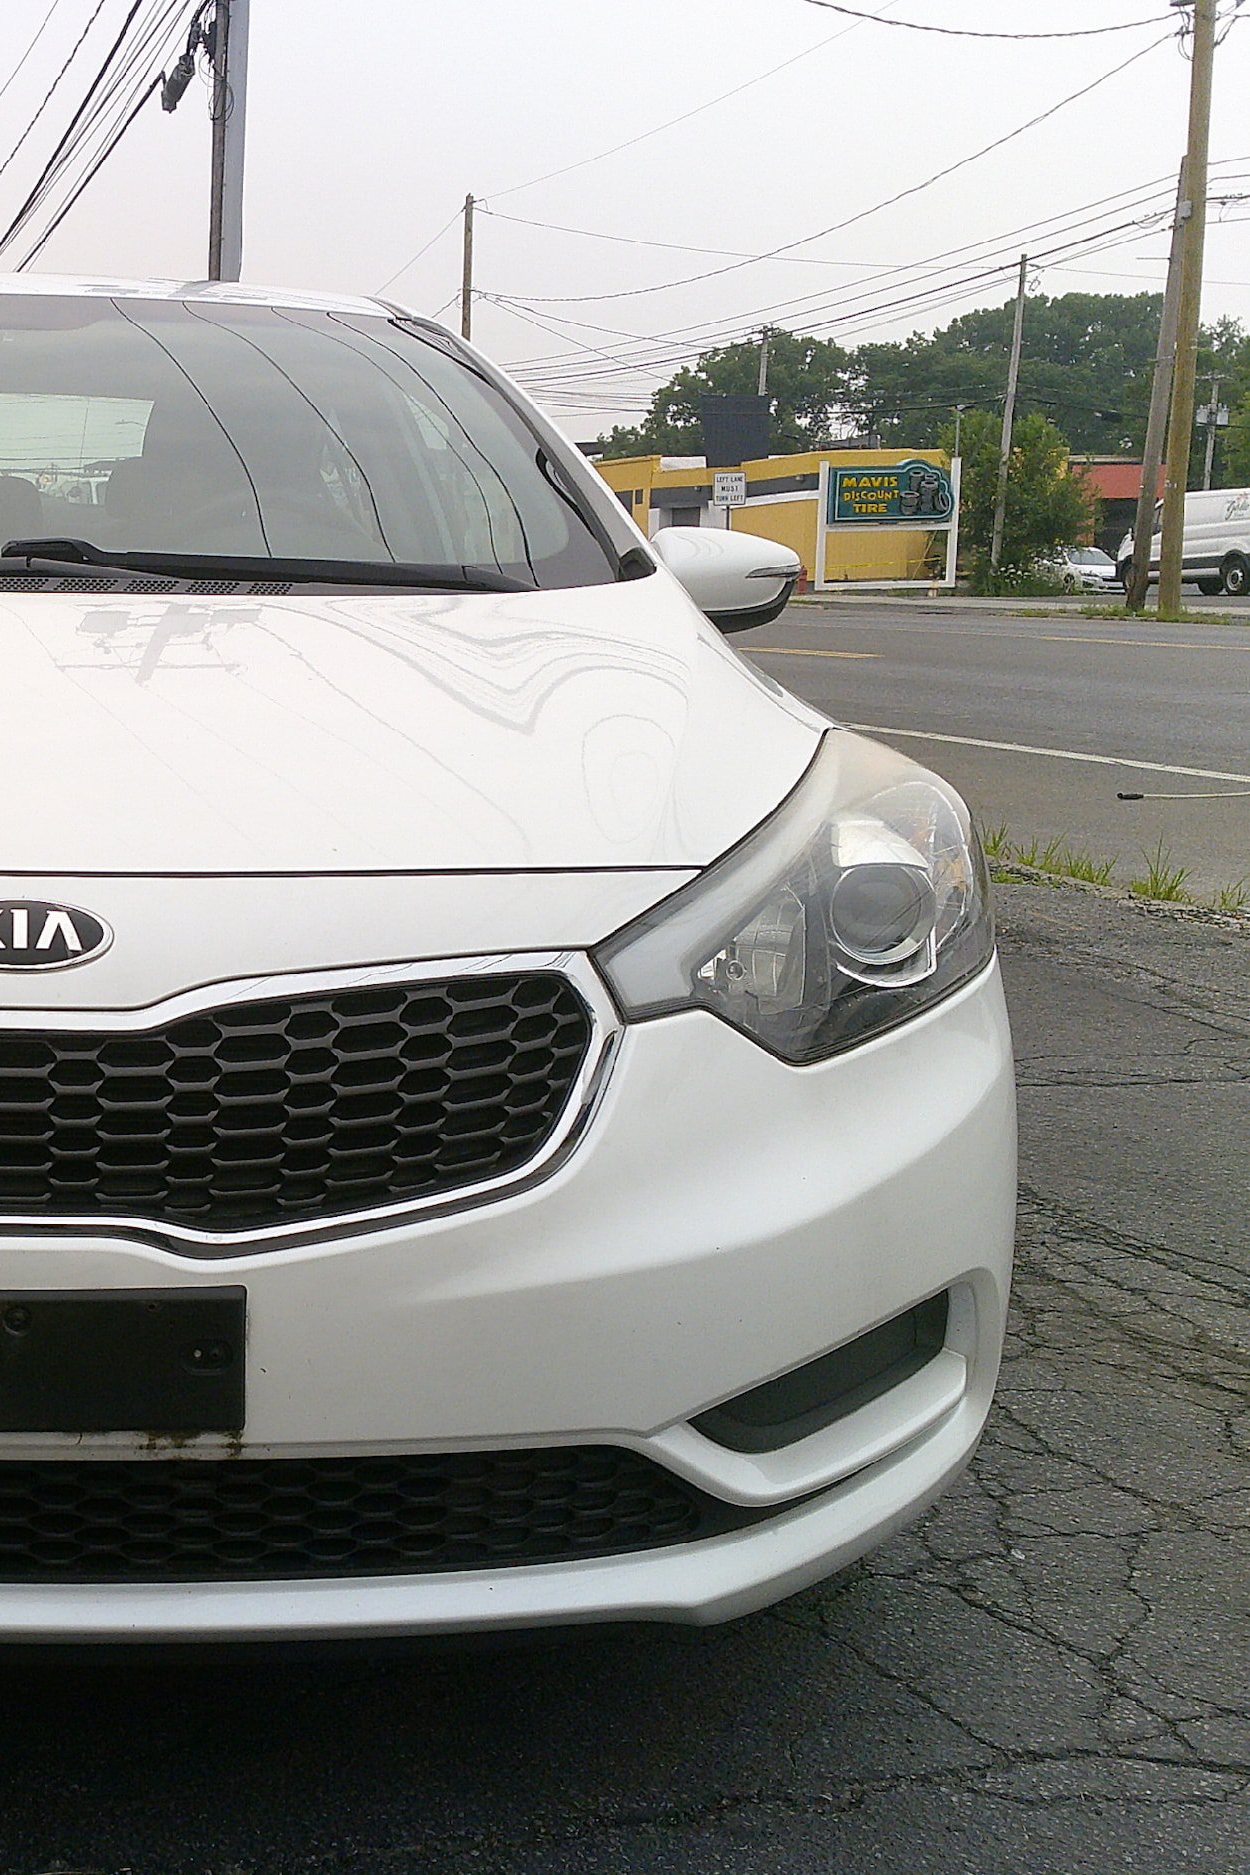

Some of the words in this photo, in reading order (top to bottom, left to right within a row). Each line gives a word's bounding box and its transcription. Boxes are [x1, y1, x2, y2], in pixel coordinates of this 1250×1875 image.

[842, 476, 898, 488] MAVIS
[843, 489, 899, 502] DISCOUNT
[852, 503, 888, 513] TIRE
